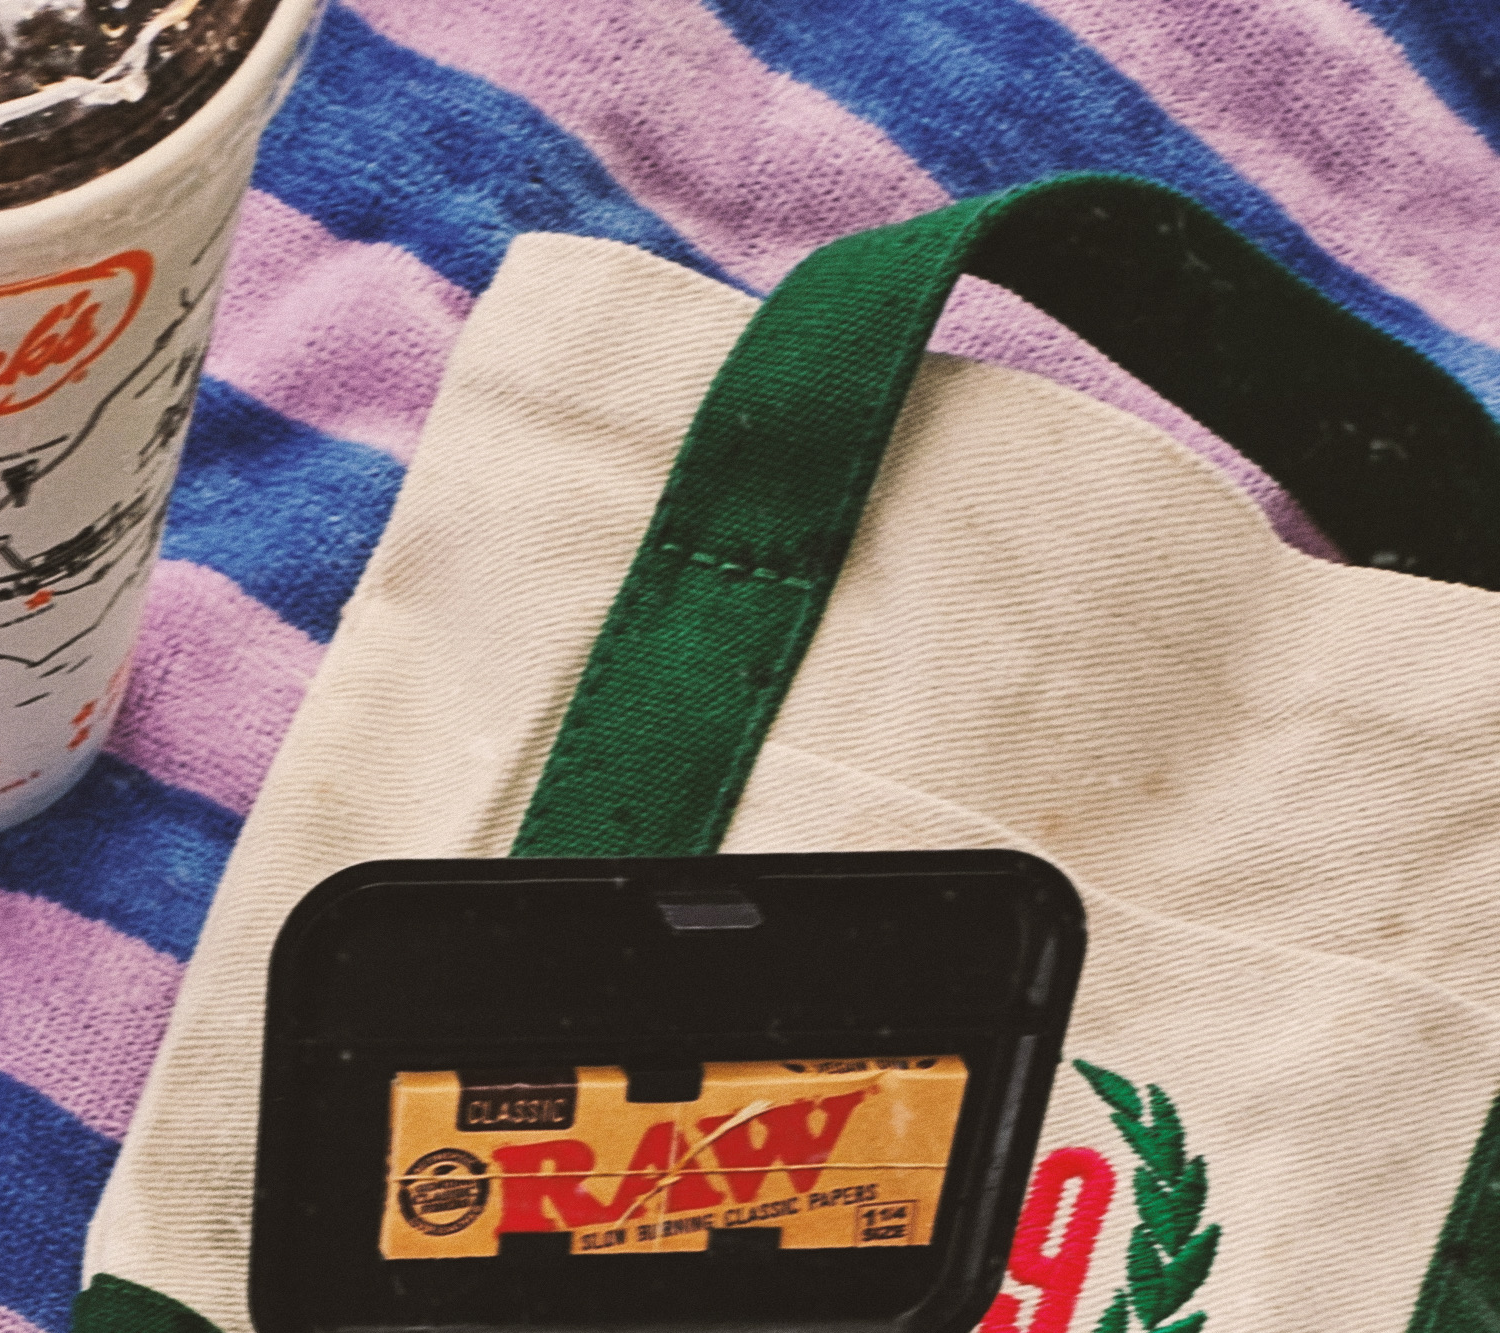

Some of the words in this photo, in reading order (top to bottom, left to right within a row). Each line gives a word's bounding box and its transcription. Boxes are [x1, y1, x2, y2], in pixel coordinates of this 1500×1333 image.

[468, 1099, 567, 1125] CLASSIC
[492, 1089, 868, 1241] RAW
[580, 1228, 626, 1251] SLOW
[636, 1213, 715, 1243] BURNING
[723, 1196, 799, 1228] CLASSIC
[807, 1183, 879, 1212] PAPERS
[862, 1224, 908, 1242] SIZE
